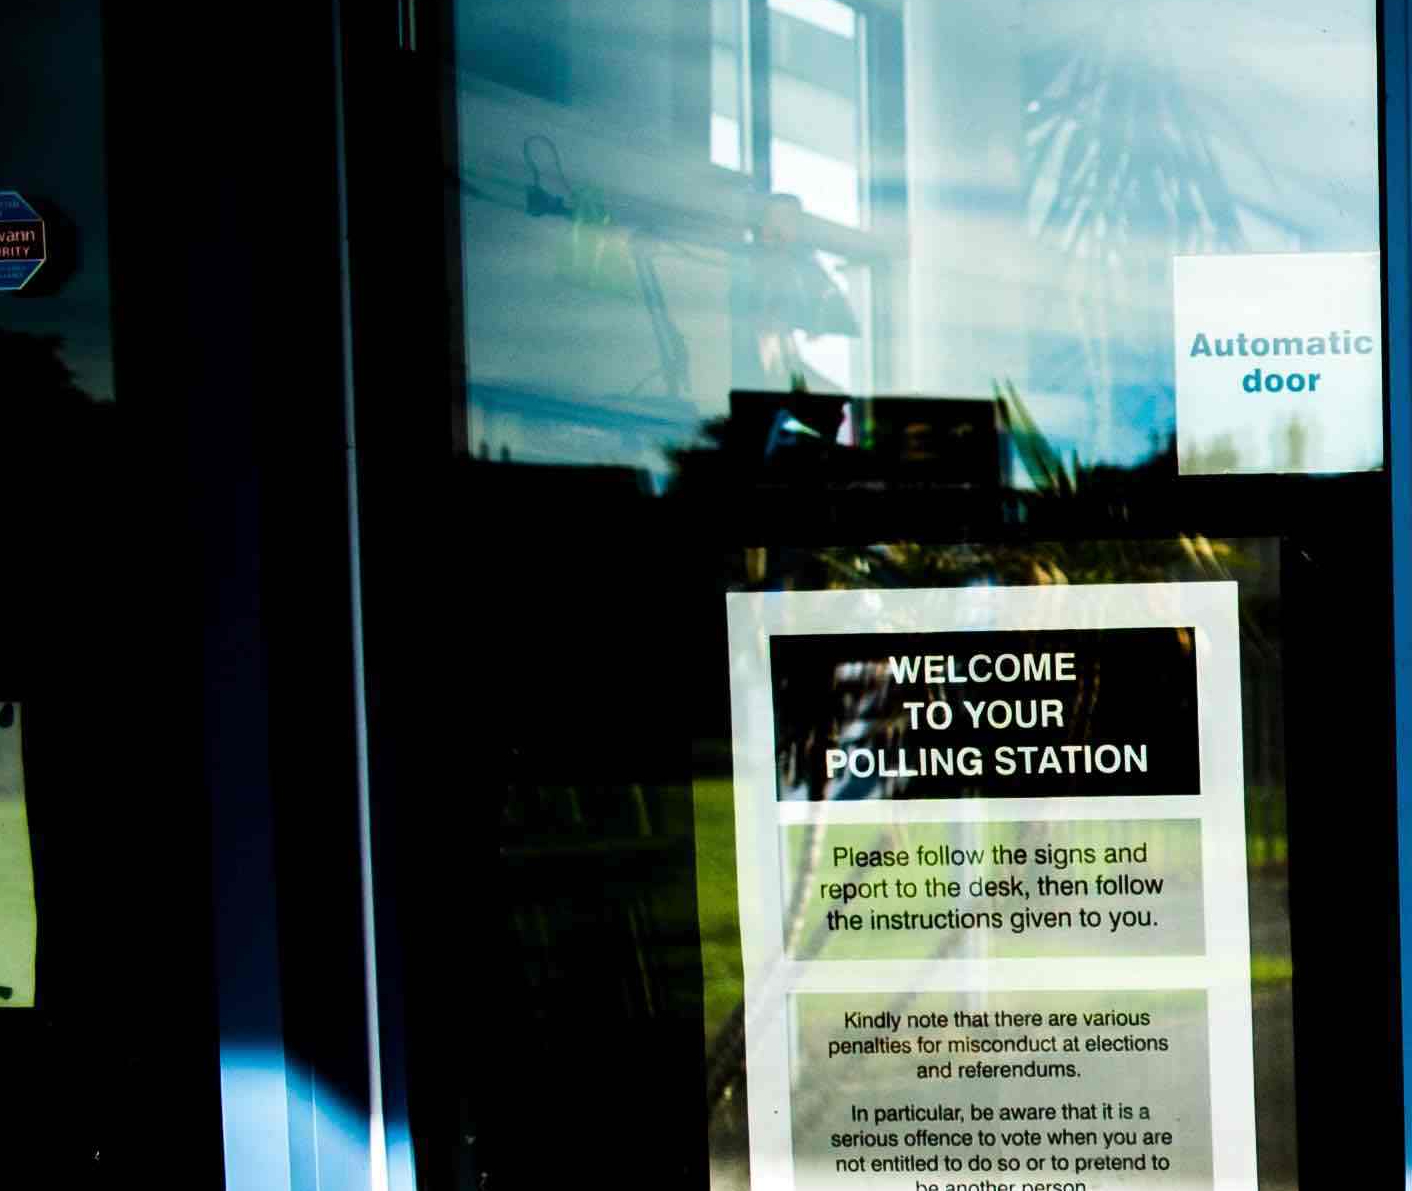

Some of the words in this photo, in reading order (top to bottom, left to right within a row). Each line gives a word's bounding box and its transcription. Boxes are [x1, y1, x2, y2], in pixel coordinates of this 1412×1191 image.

[1190, 329, 1373, 357] Automatic
[1242, 368, 1321, 393] door
[890, 652, 1077, 684] WELCOME
[904, 700, 953, 731] TO
[965, 699, 1064, 729] YOUR
[826, 747, 982, 778] POLLING
[996, 744, 1148, 775] STATION
[833, 846, 909, 868] Please
[917, 844, 984, 866] follow
[1035, 844, 1096, 870] signs
[1104, 842, 1147, 863] and
[820, 878, 890, 904] report
[969, 876, 1030, 899] desk,
[1037, 876, 1088, 896] then
[1096, 875, 1163, 895] follow
[871, 908, 1002, 930] instructions
[1011, 908, 1071, 934] given
[1109, 909, 1159, 933] you.
[844, 1011, 900, 1032] Kindly
[907, 1011, 948, 1028] note
[954, 1010, 989, 1028] that
[995, 1010, 1041, 1027] there
[1049, 1011, 1077, 1027] are
[1084, 1010, 1150, 1027] various
[828, 1036, 911, 1058] penalties
[917, 1035, 941, 1053] for
[948, 1035, 1057, 1052] misconduct
[1085, 1034, 1169, 1052] elections
[917, 1061, 952, 1079] and
[958, 1060, 1081, 1078] referendums.
[851, 1104, 868, 1122] In
[875, 1103, 965, 1127] particular,
[1000, 1106, 1055, 1121] aware
[1062, 1103, 1098, 1121] that
[831, 1129, 898, 1147] serious
[905, 1128, 972, 1147] offence
[1002, 1129, 1041, 1146] vote
[1047, 1128, 1097, 1146] when
[1103, 1131, 1137, 1149] you
[1143, 1130, 1172, 1145] are
[836, 1155, 866, 1172] not
[872, 1153, 938, 1172] entitled
[1075, 1153, 1146, 1173] pretend
